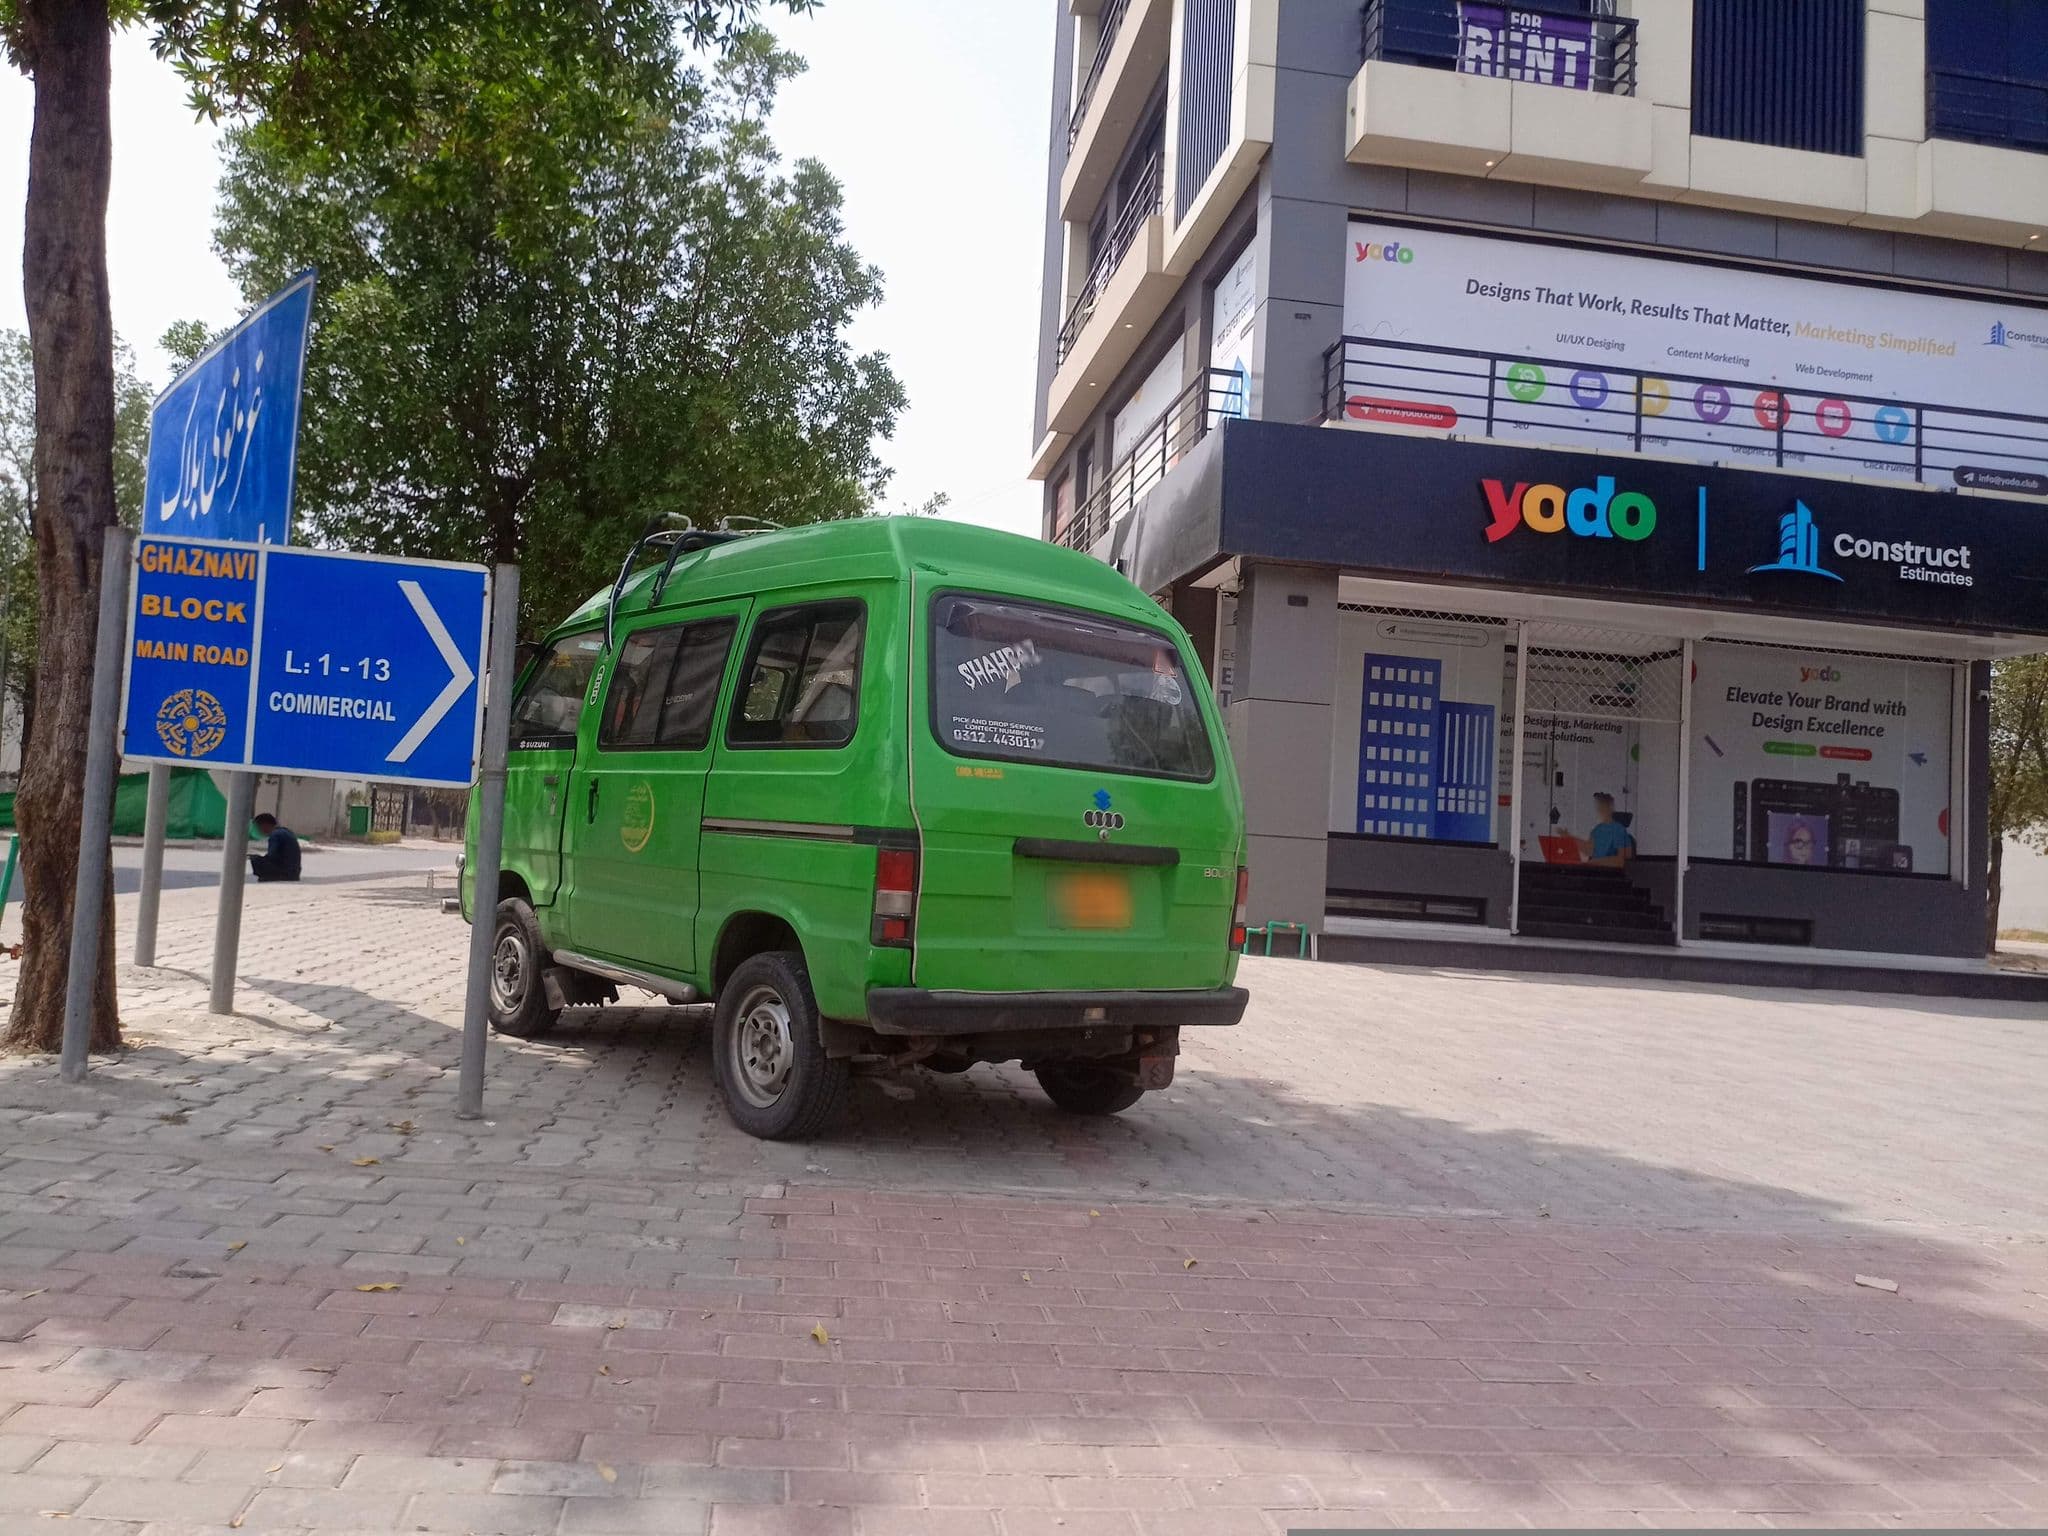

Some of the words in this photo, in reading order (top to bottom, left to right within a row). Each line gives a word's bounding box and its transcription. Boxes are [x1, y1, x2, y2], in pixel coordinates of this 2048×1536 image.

[1510, 12, 1542, 33] FOR
[1465, 25, 1586, 87] RENT
[1355, 242, 1413, 264] yodo
[1466, 278, 1531, 302] Designs
[1535, 286, 1573, 307] That
[1578, 291, 1626, 315] Work,
[1631, 299, 1689, 321] Results
[1693, 306, 1731, 327] That
[1733, 312, 1791, 337] Matter,
[1795, 320, 1876, 349] Marketing
[1879, 332, 1957, 357] Simplified
[1556, 333, 1584, 346] UI/UX
[1667, 346, 1703, 360] Content
[1704, 351, 1750, 367] Marketing
[1795, 363, 1815, 375] Web
[1816, 366, 1873, 382] Development
[1481, 476, 1657, 543] yodo
[141, 544, 256, 581] GHAZNAVI
[1833, 532, 1971, 569] Construct
[1900, 566, 1973, 587] Estimates
[141, 594, 247, 623] BLOCK
[136, 639, 189, 662] MAIN
[193, 644, 249, 667] ROAD
[285, 650, 310, 674] L:
[318, 653, 330, 676] 1
[358, 657, 391, 682] 13
[269, 691, 397, 721] COMMERCIAL
[1726, 687, 1783, 706] Elevate
[1787, 691, 1822, 709] Your
[1824, 695, 1869, 713] Brand
[1873, 701, 1907, 716] with
[999, 728, 1030, 736] NUMBER
[1009, 722, 1044, 733] SERVICES
[1549, 731, 1595, 744] Solutions.
[1573, 719, 1623, 734] Marketing
[1752, 712, 1803, 733] Design
[1806, 716, 1885, 738] Excellence
